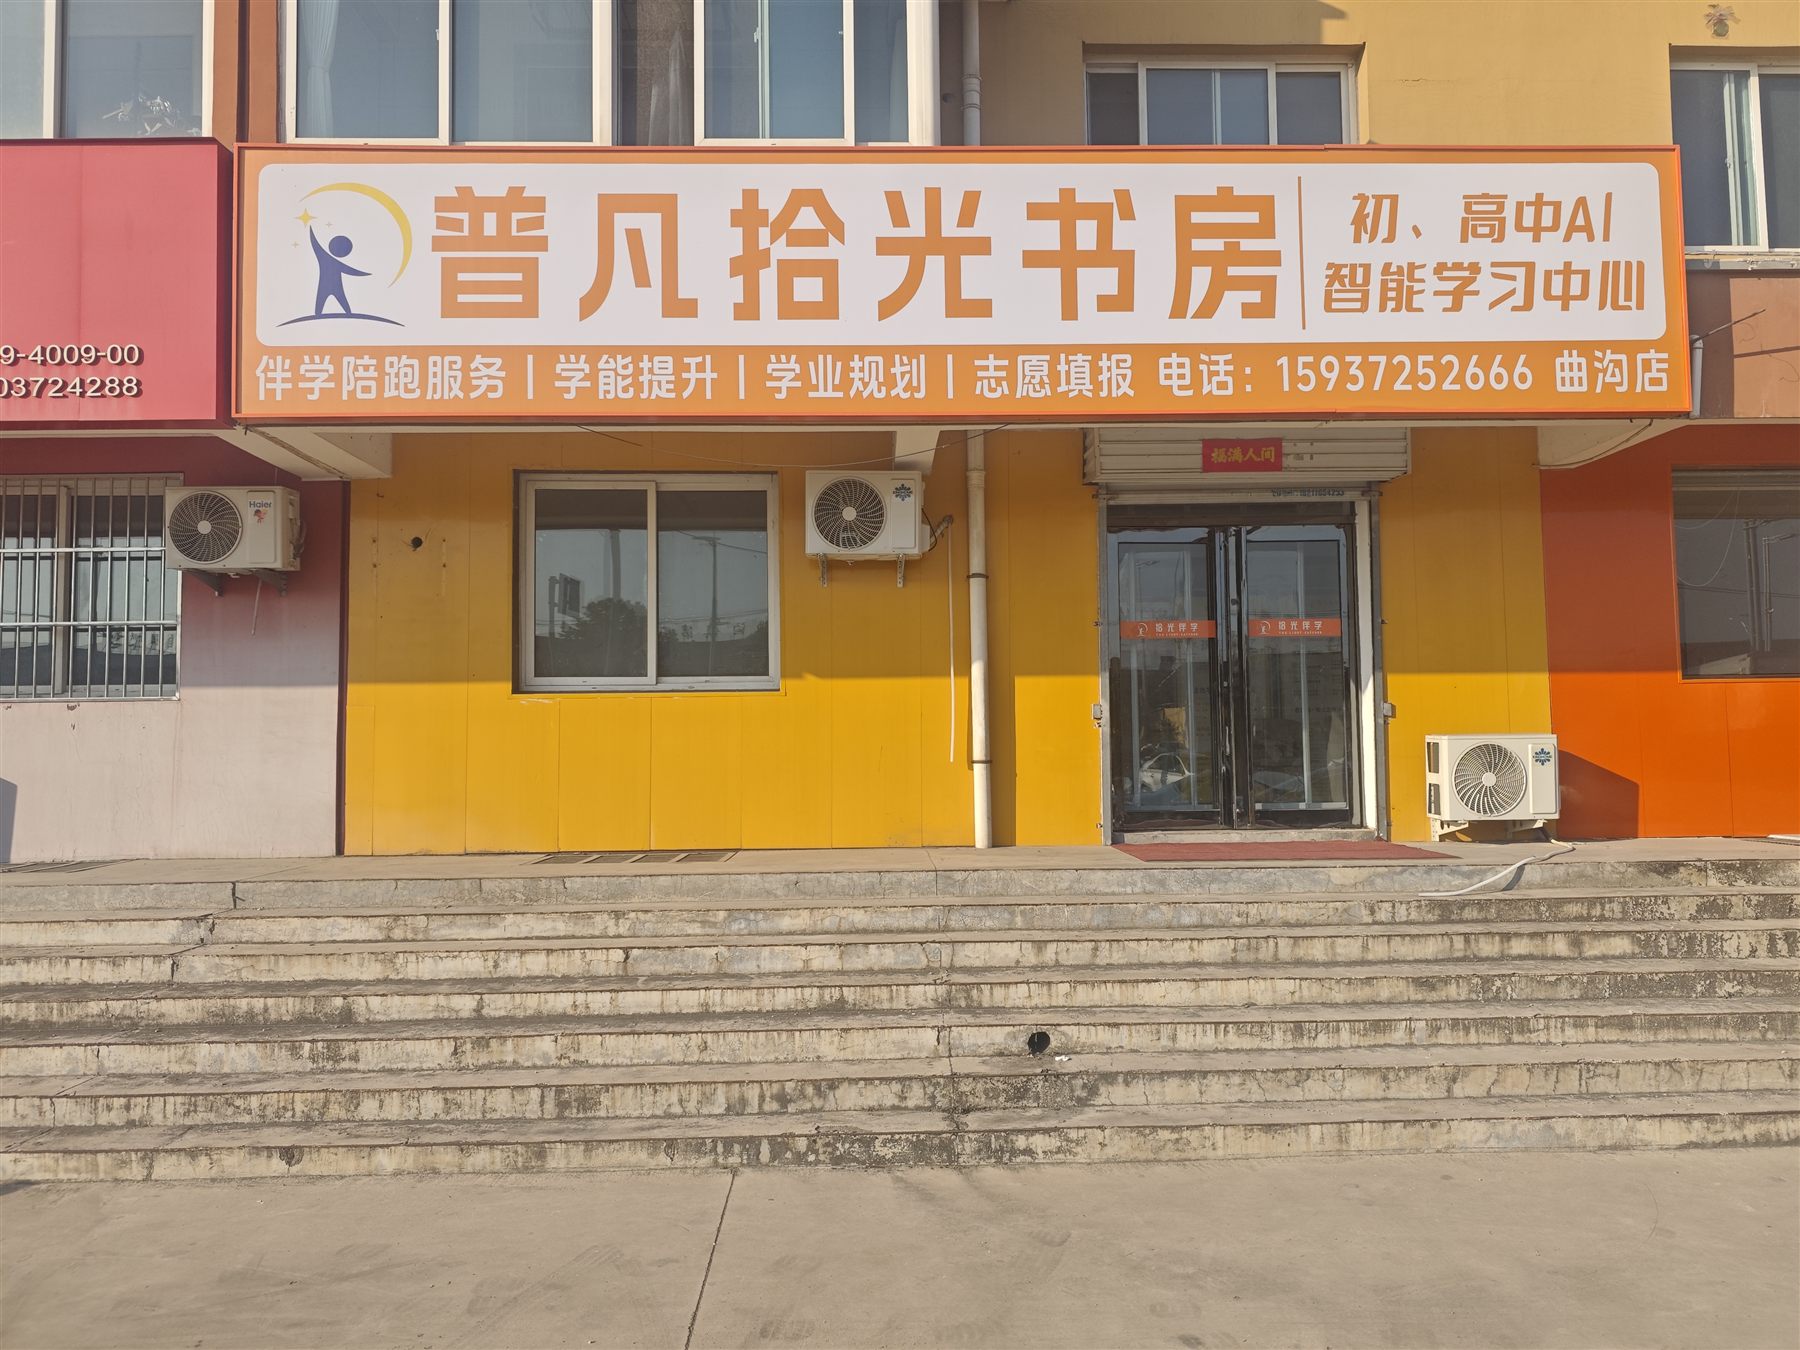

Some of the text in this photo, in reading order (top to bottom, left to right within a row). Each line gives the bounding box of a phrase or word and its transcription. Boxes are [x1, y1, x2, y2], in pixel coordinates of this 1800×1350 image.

[432, 186, 1282, 321] 普凡拾光书房
[1323, 260, 1645, 314] 智能学习中心
[0, 344, 139, 364] 9-4009-00
[1555, 348, 1669, 393] 曲沟店
[249, 500, 272, 508] Haier
